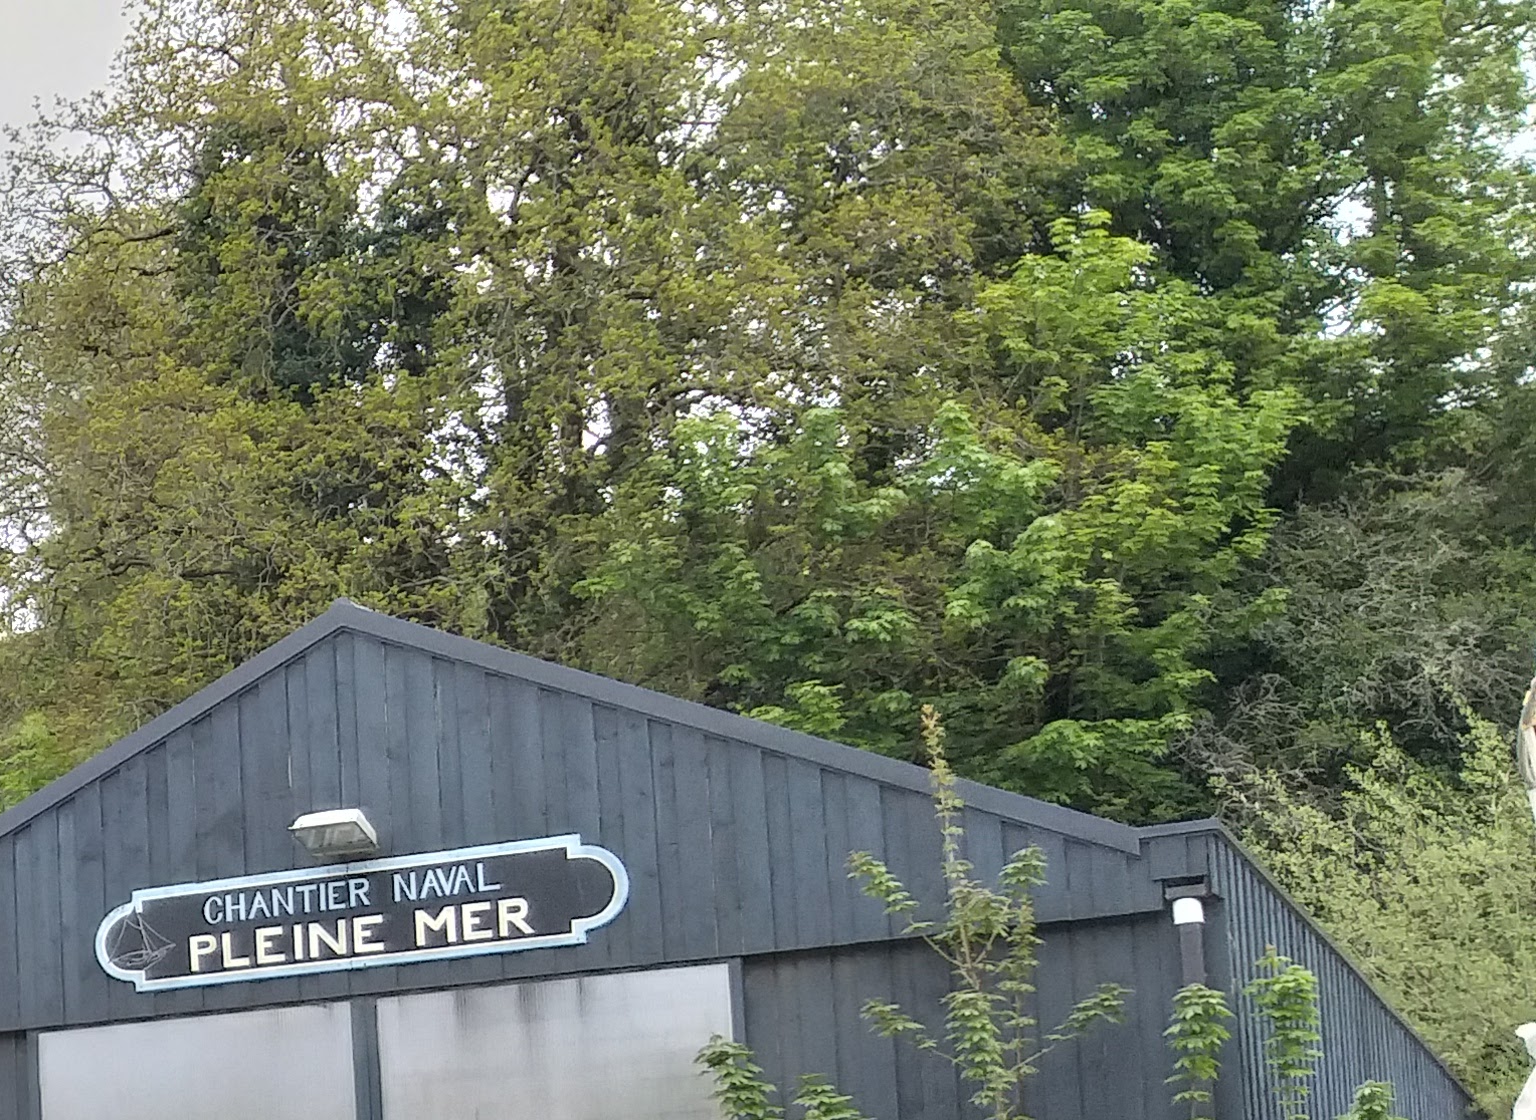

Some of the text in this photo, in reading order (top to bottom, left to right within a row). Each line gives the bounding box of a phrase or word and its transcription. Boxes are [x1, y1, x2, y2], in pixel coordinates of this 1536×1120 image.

[203, 863, 501, 925] CHANTIER NAVAL
[189, 897, 536, 973] PLEINE MER
